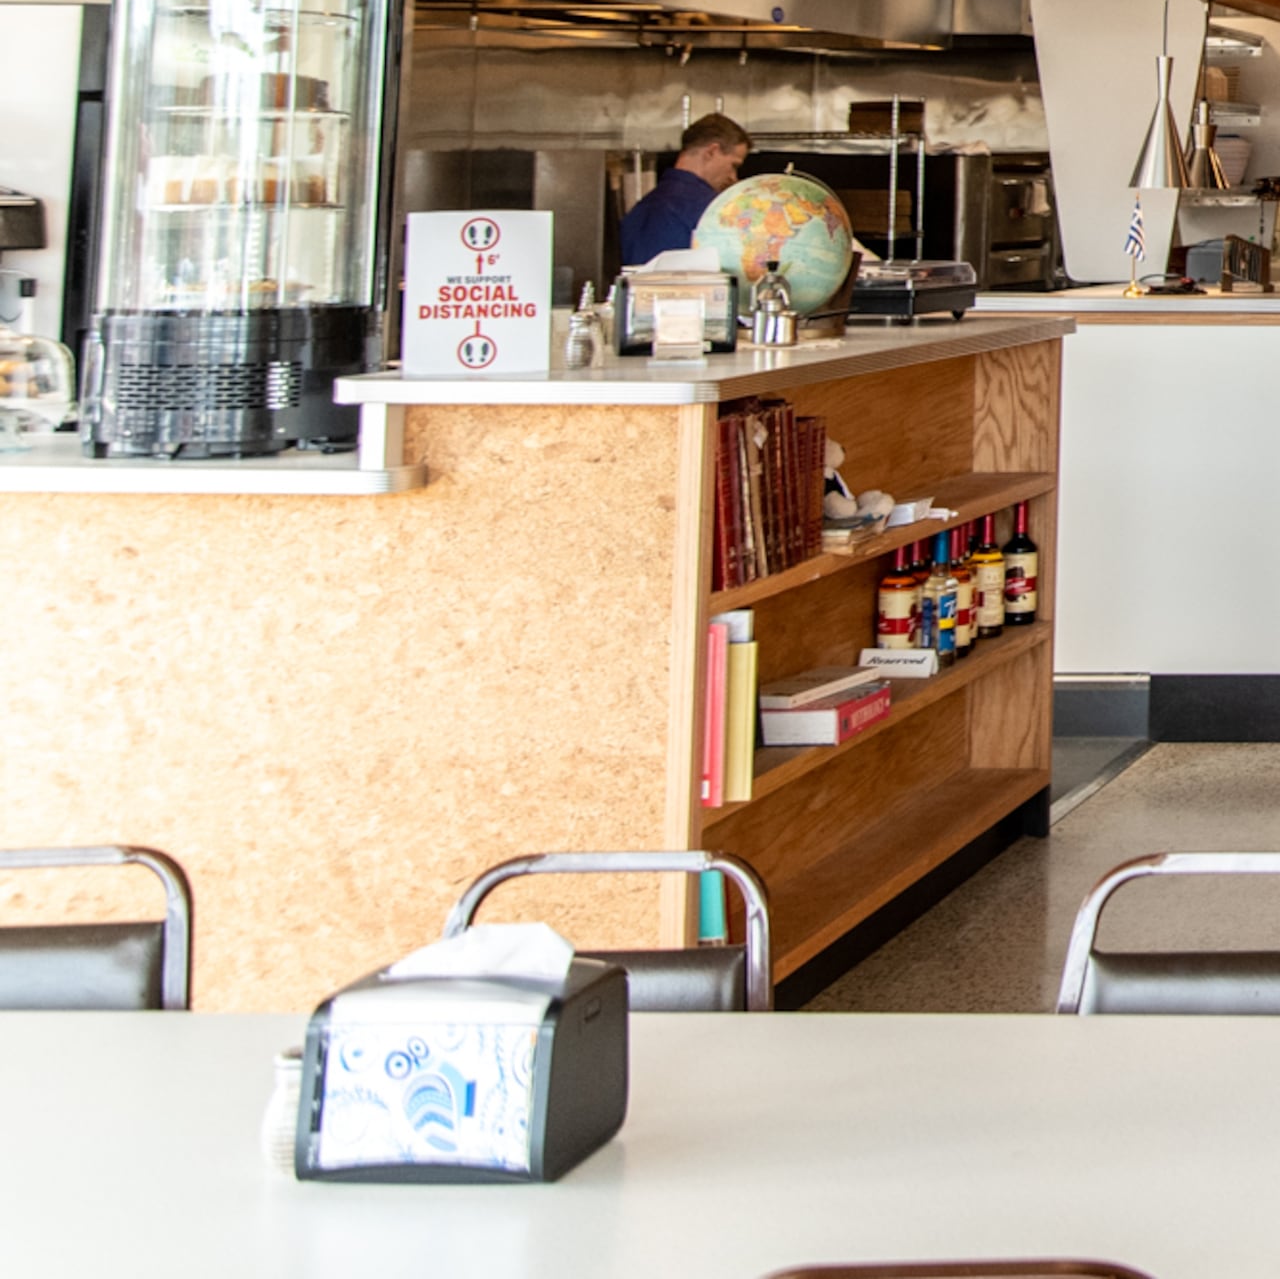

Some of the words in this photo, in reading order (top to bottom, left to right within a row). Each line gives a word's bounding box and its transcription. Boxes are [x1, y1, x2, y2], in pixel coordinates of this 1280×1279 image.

[447, 276, 462, 284] WE
[464, 275, 512, 284] SUPPORT
[438, 285, 519, 302] SOCIAL
[418, 303, 537, 319] DISTANCING
[866, 656, 928, 665] Reserved
